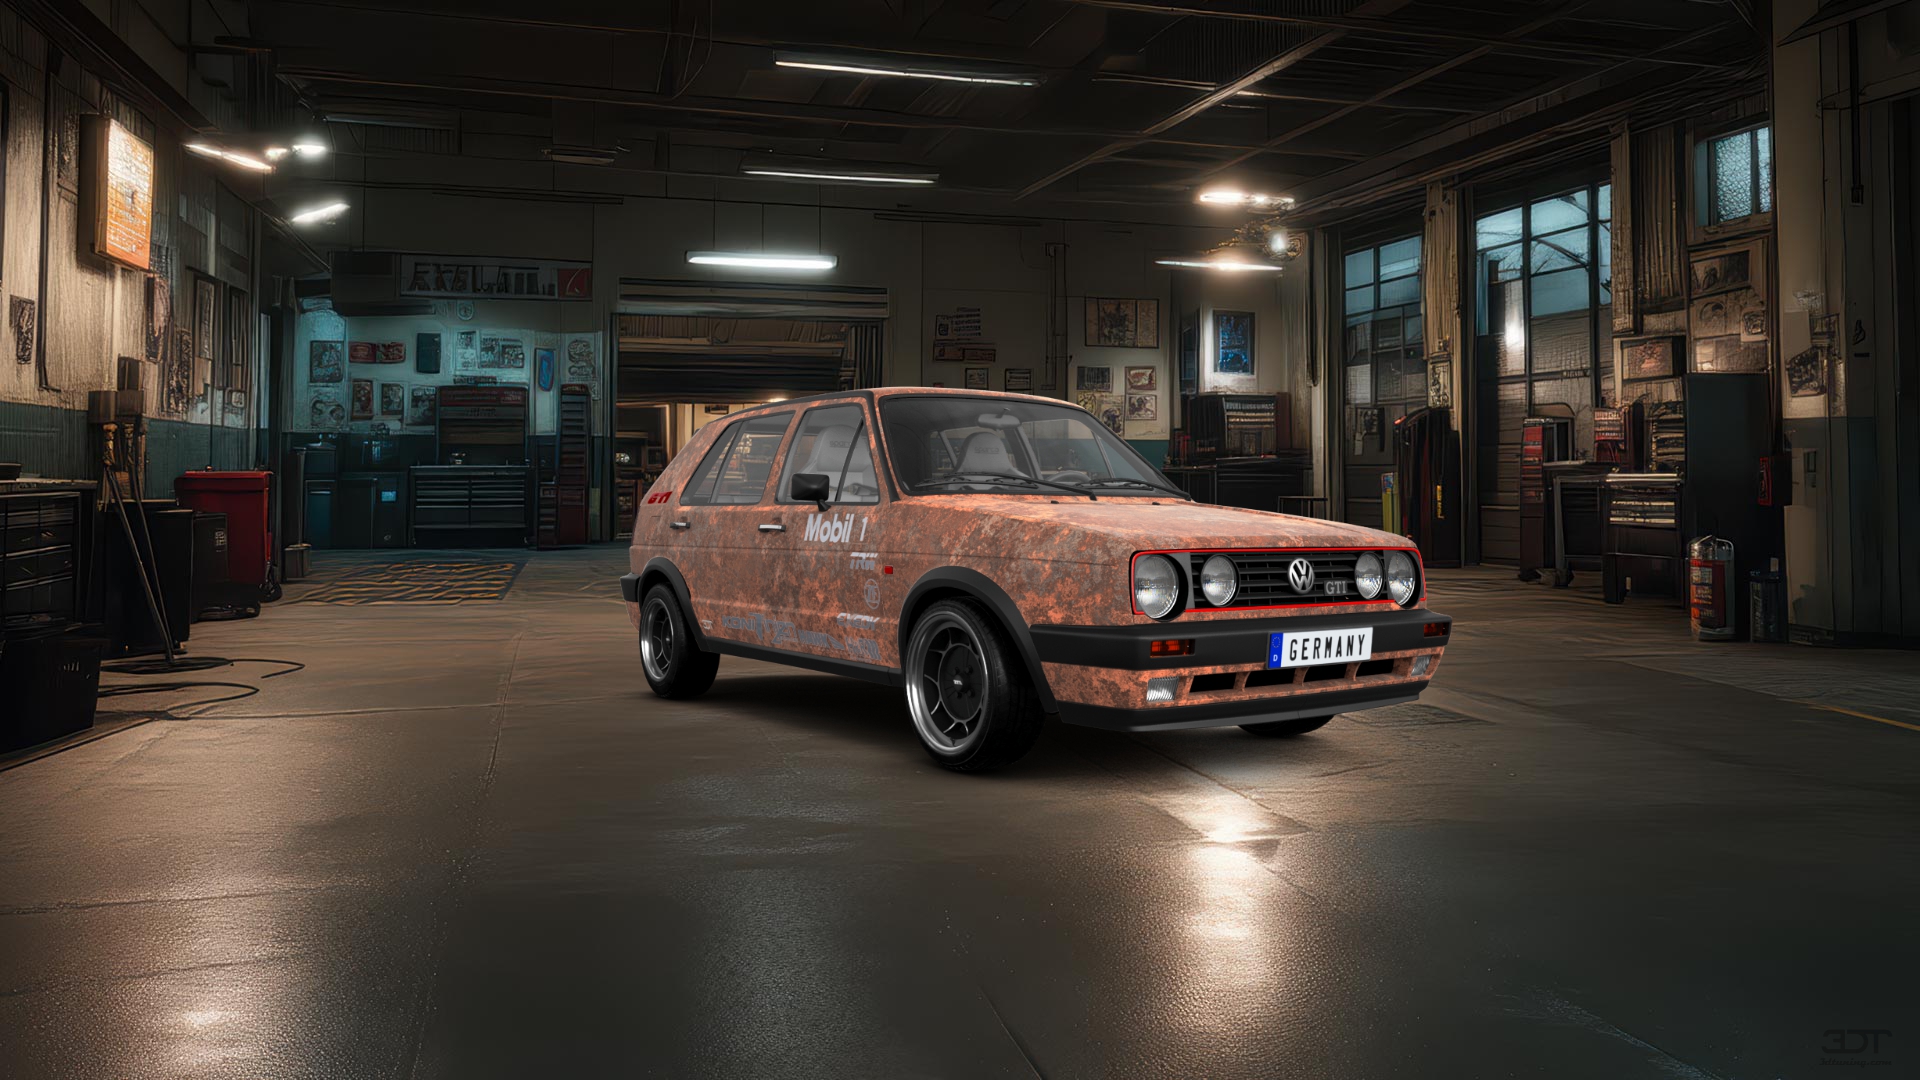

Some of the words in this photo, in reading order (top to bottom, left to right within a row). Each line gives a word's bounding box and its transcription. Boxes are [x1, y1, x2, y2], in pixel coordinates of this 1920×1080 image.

[804, 513, 855, 543] Mobil
[860, 517, 868, 541] 1
[850, 552, 878, 570] TRW
[1325, 581, 1347, 594] GTI
[722, 615, 756, 631] KONI
[1289, 634, 1365, 661] GERMANY
